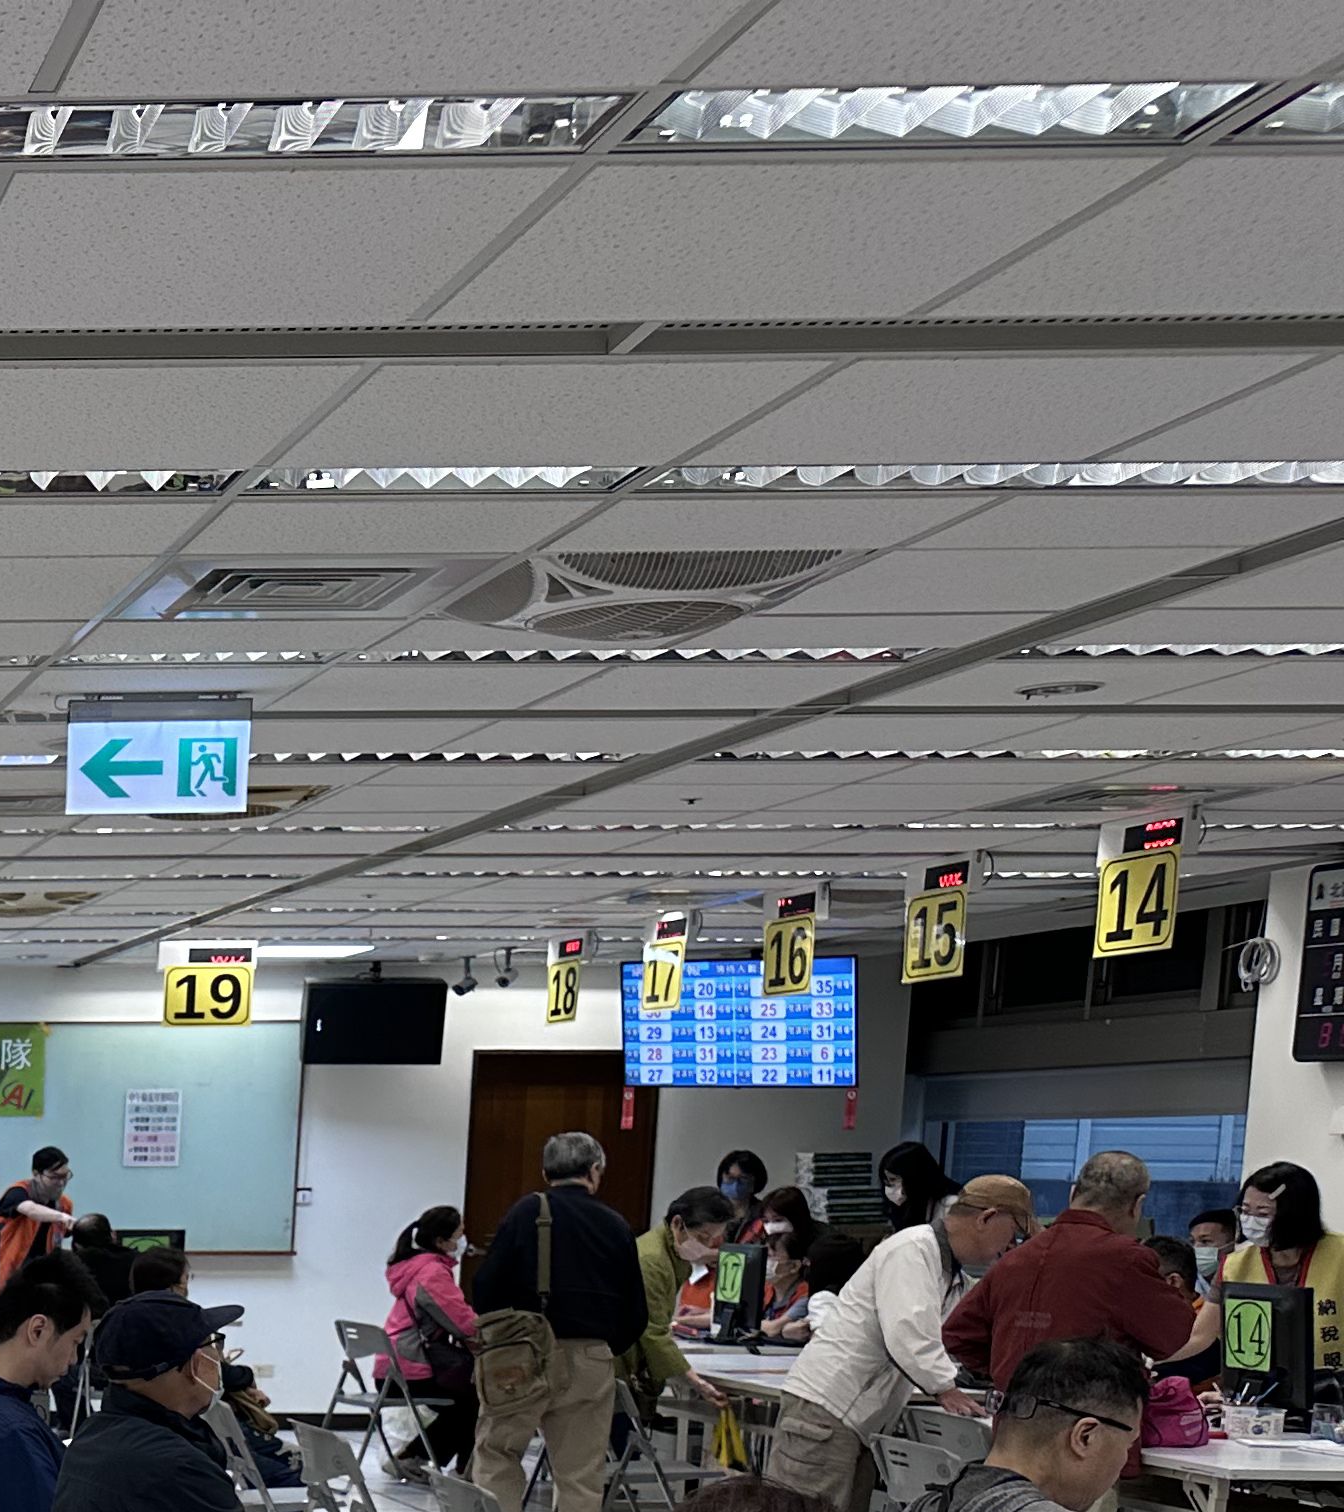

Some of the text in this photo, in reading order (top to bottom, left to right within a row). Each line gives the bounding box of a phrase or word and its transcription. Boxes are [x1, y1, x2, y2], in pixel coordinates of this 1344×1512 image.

[1105, 863, 1169, 943] 14
[911, 901, 957, 970] 15
[768, 927, 808, 988] 16
[644, 950, 679, 1004] 17
[550, 967, 577, 1017] 18
[698, 983, 712, 996] 20
[816, 980, 832, 993] 35
[173, 974, 243, 1019] 19
[699, 1004, 713, 1017] 14
[761, 1003, 777, 1017] 25
[816, 1002, 832, 1015] 33
[646, 1026, 662, 1040] 29
[700, 1026, 714, 1039] 13
[761, 1025, 777, 1038] 24
[816, 1024, 832, 1038] 31
[647, 1048, 662, 1061] 28
[699, 1048, 714, 1061] 31
[761, 1047, 778, 1060] 23
[820, 1047, 829, 1060] 6
[648, 1069, 663, 1082] 27
[700, 1070, 714, 1083] 32
[761, 1069, 778, 1082] 22
[817, 1069, 832, 1082] 11
[719, 1259, 743, 1292] 17
[1233, 1311, 1265, 1356] 14
